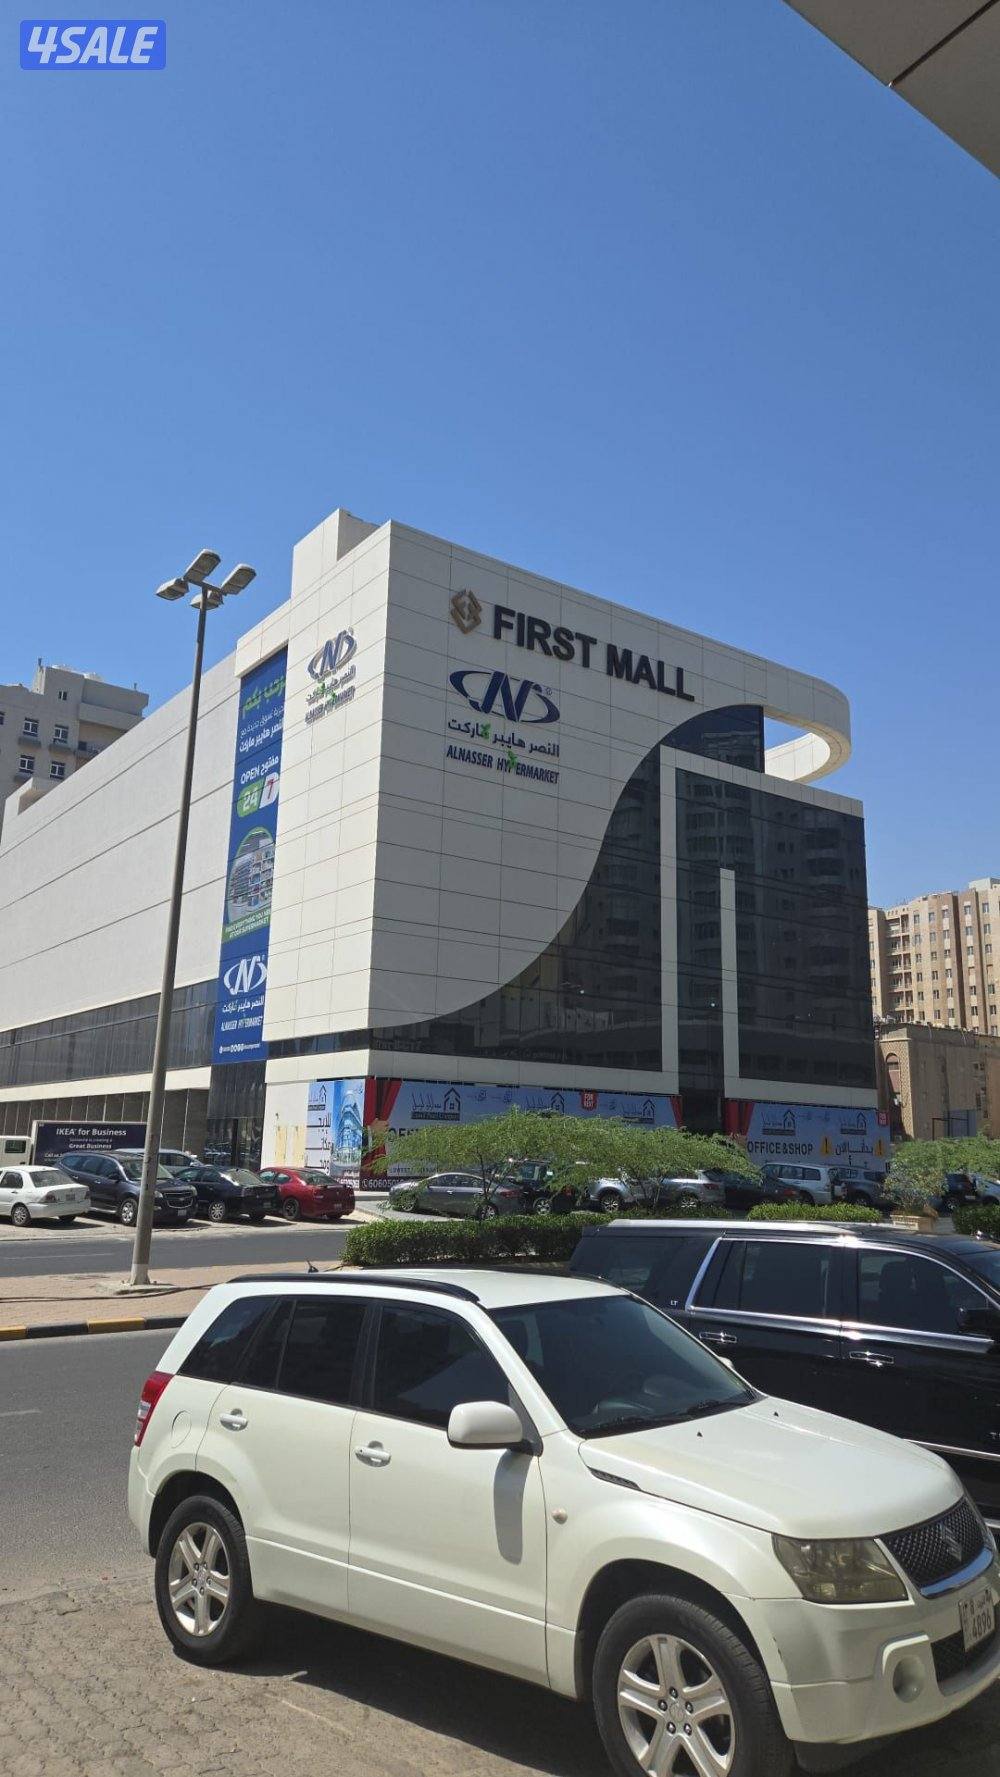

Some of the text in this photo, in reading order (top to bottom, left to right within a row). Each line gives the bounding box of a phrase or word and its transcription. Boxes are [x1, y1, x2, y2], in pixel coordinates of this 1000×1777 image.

[493, 604, 695, 702] FIRST MALL
[492, 732, 526, 749] هايبر
[528, 741, 560, 758] النصر
[260, 755, 280, 776] مفتوح
[446, 744, 560, 785] ALNASSER HYPERMARKET
[240, 764, 261, 785] OPEN
[78, 1128, 90, 1136] for
[92, 1128, 127, 1136] Business
[746, 1141, 813, 1156] OFFICE&SHOP
